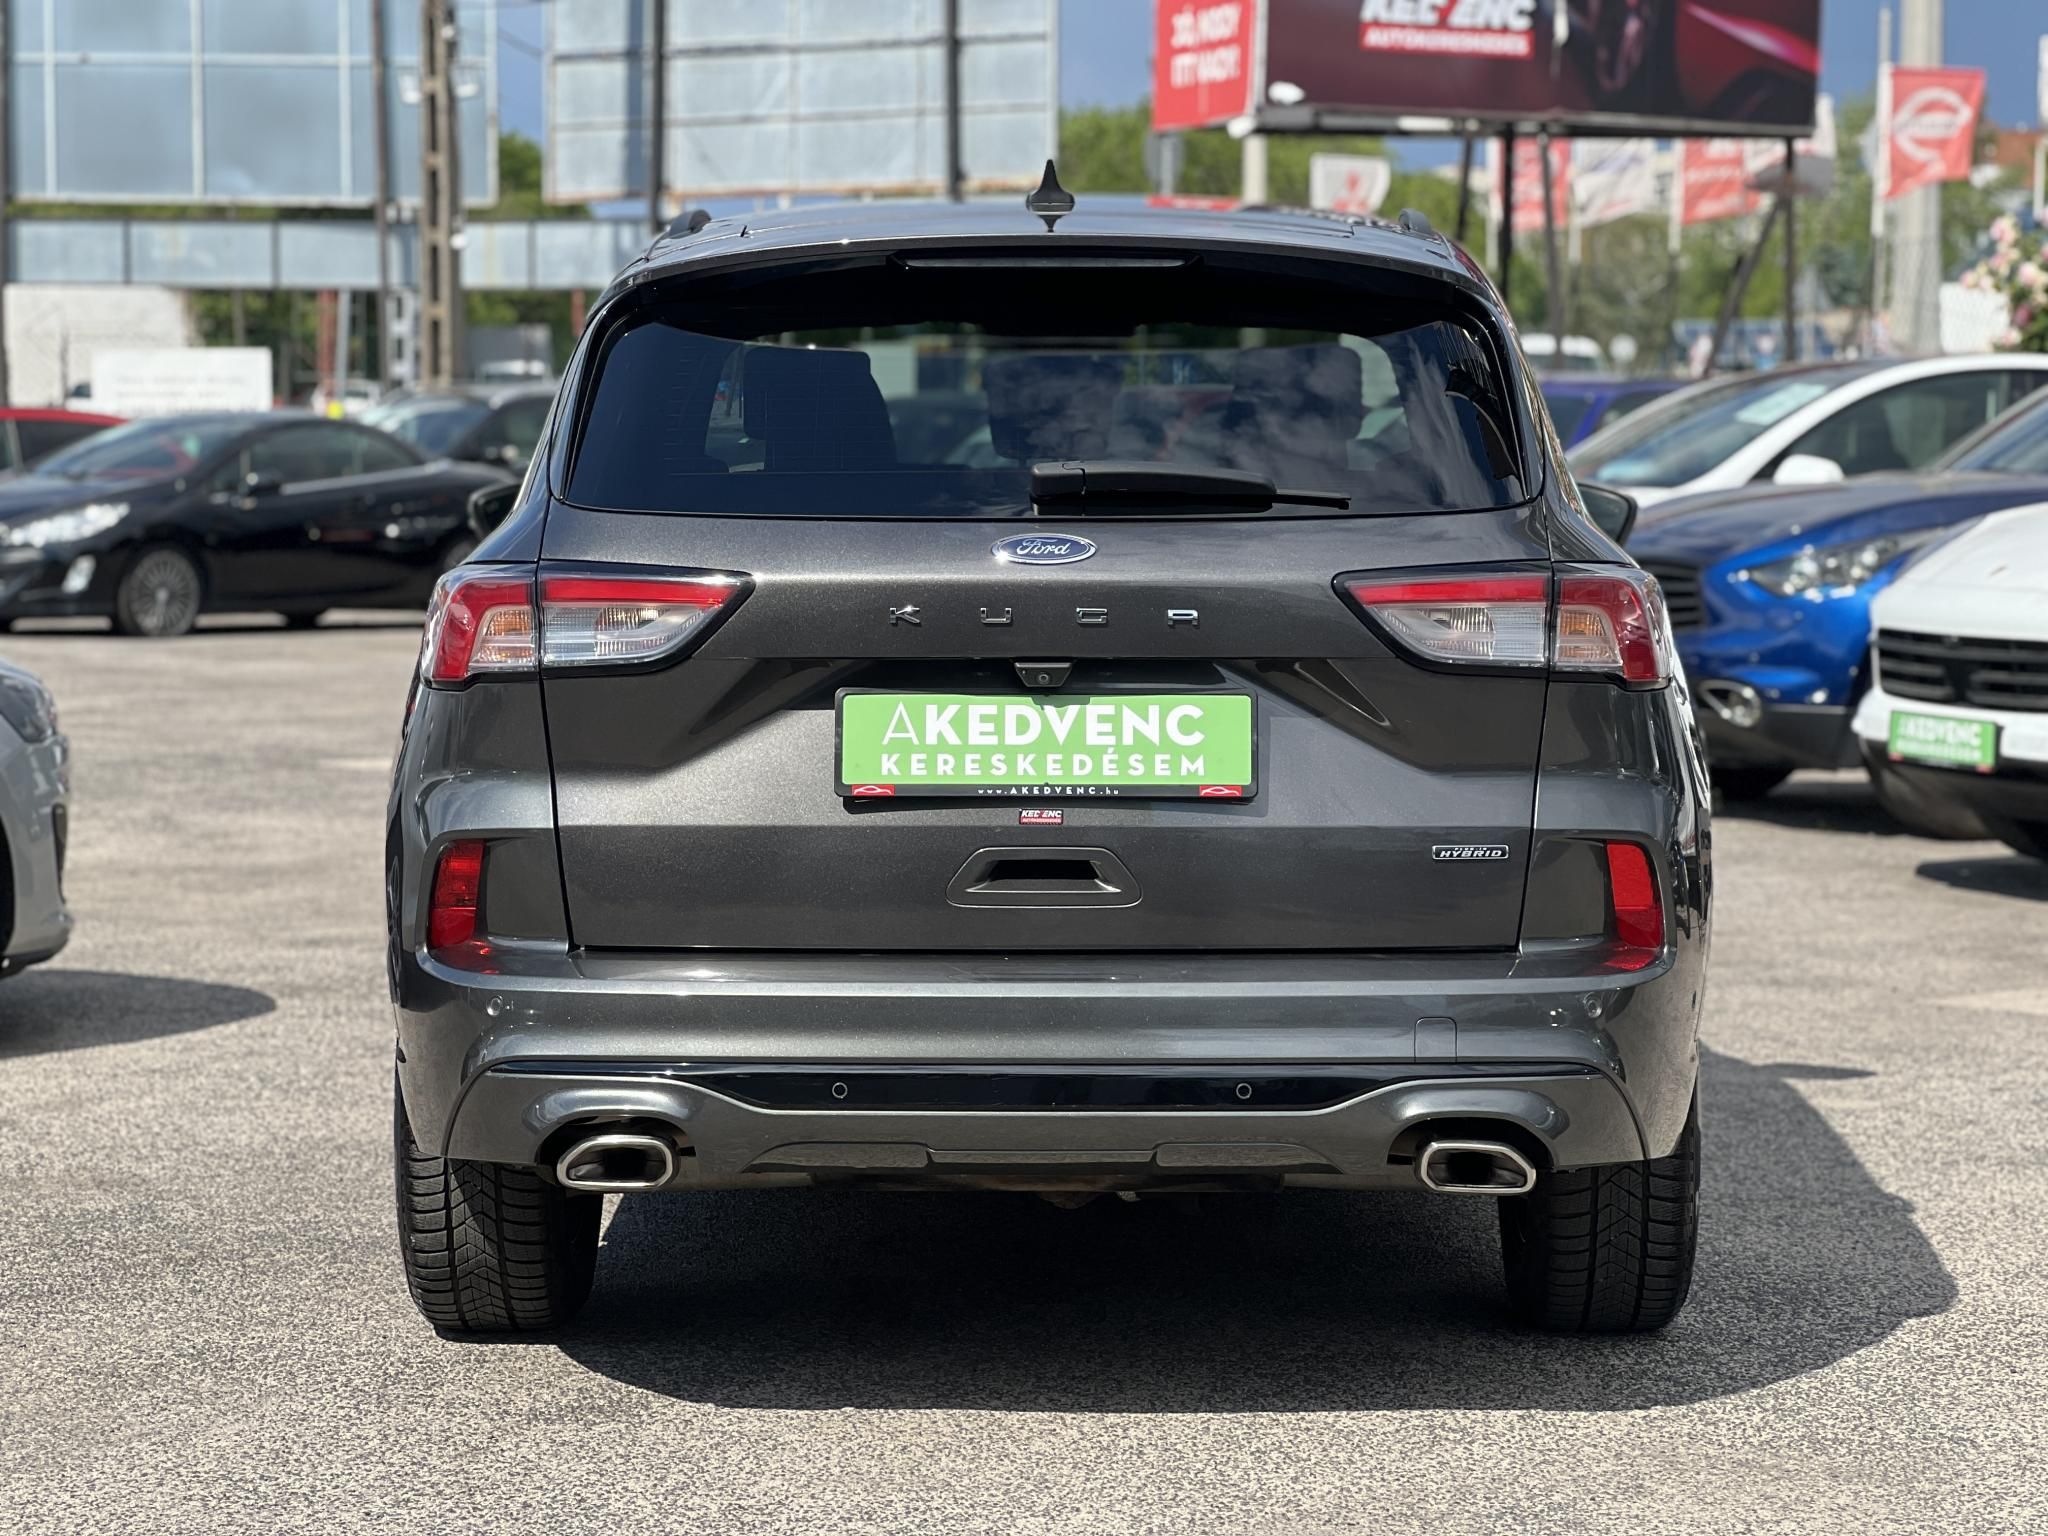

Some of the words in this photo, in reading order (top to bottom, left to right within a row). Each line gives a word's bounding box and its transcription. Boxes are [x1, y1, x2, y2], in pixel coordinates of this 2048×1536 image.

[1016, 538, 1071, 554] Ford
[889, 607, 1199, 625] KUGA
[880, 747, 1206, 777] KERESKEDÉSEM
[977, 786, 1120, 796] www.AKEDVENC.hu
[1439, 850, 1503, 858] HYBRID
